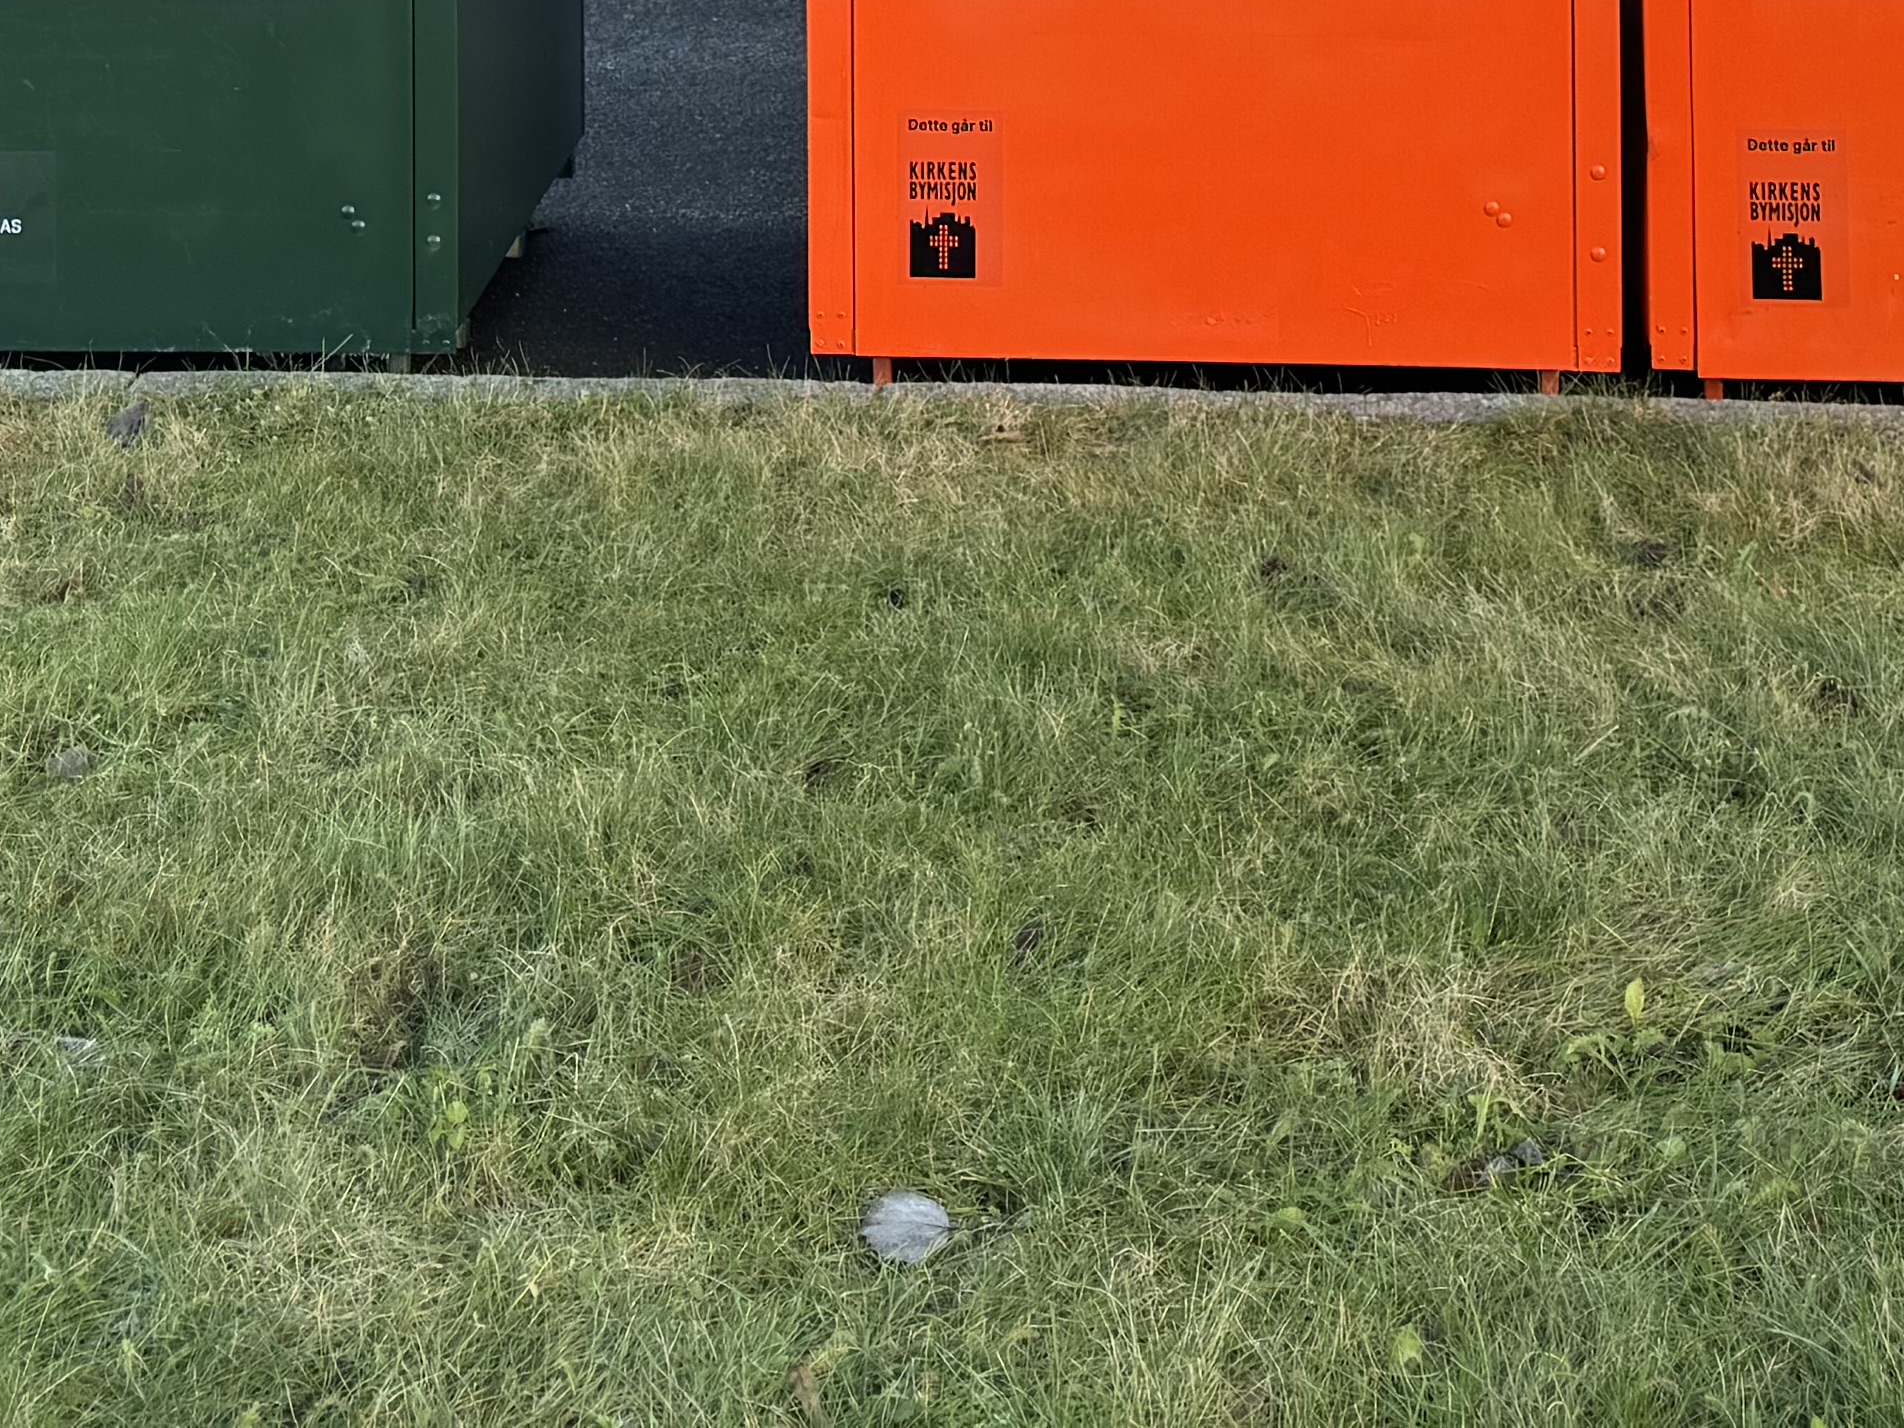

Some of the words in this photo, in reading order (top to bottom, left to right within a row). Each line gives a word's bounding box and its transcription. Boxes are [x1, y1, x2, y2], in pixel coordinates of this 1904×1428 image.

[910, 161, 976, 180] KIRKENS
[910, 182, 976, 206] BYMISJON
[1749, 182, 1820, 201] KIRKENS
[1750, 202, 1821, 227] BYMISJON
[0, 219, 22, 234] AS
